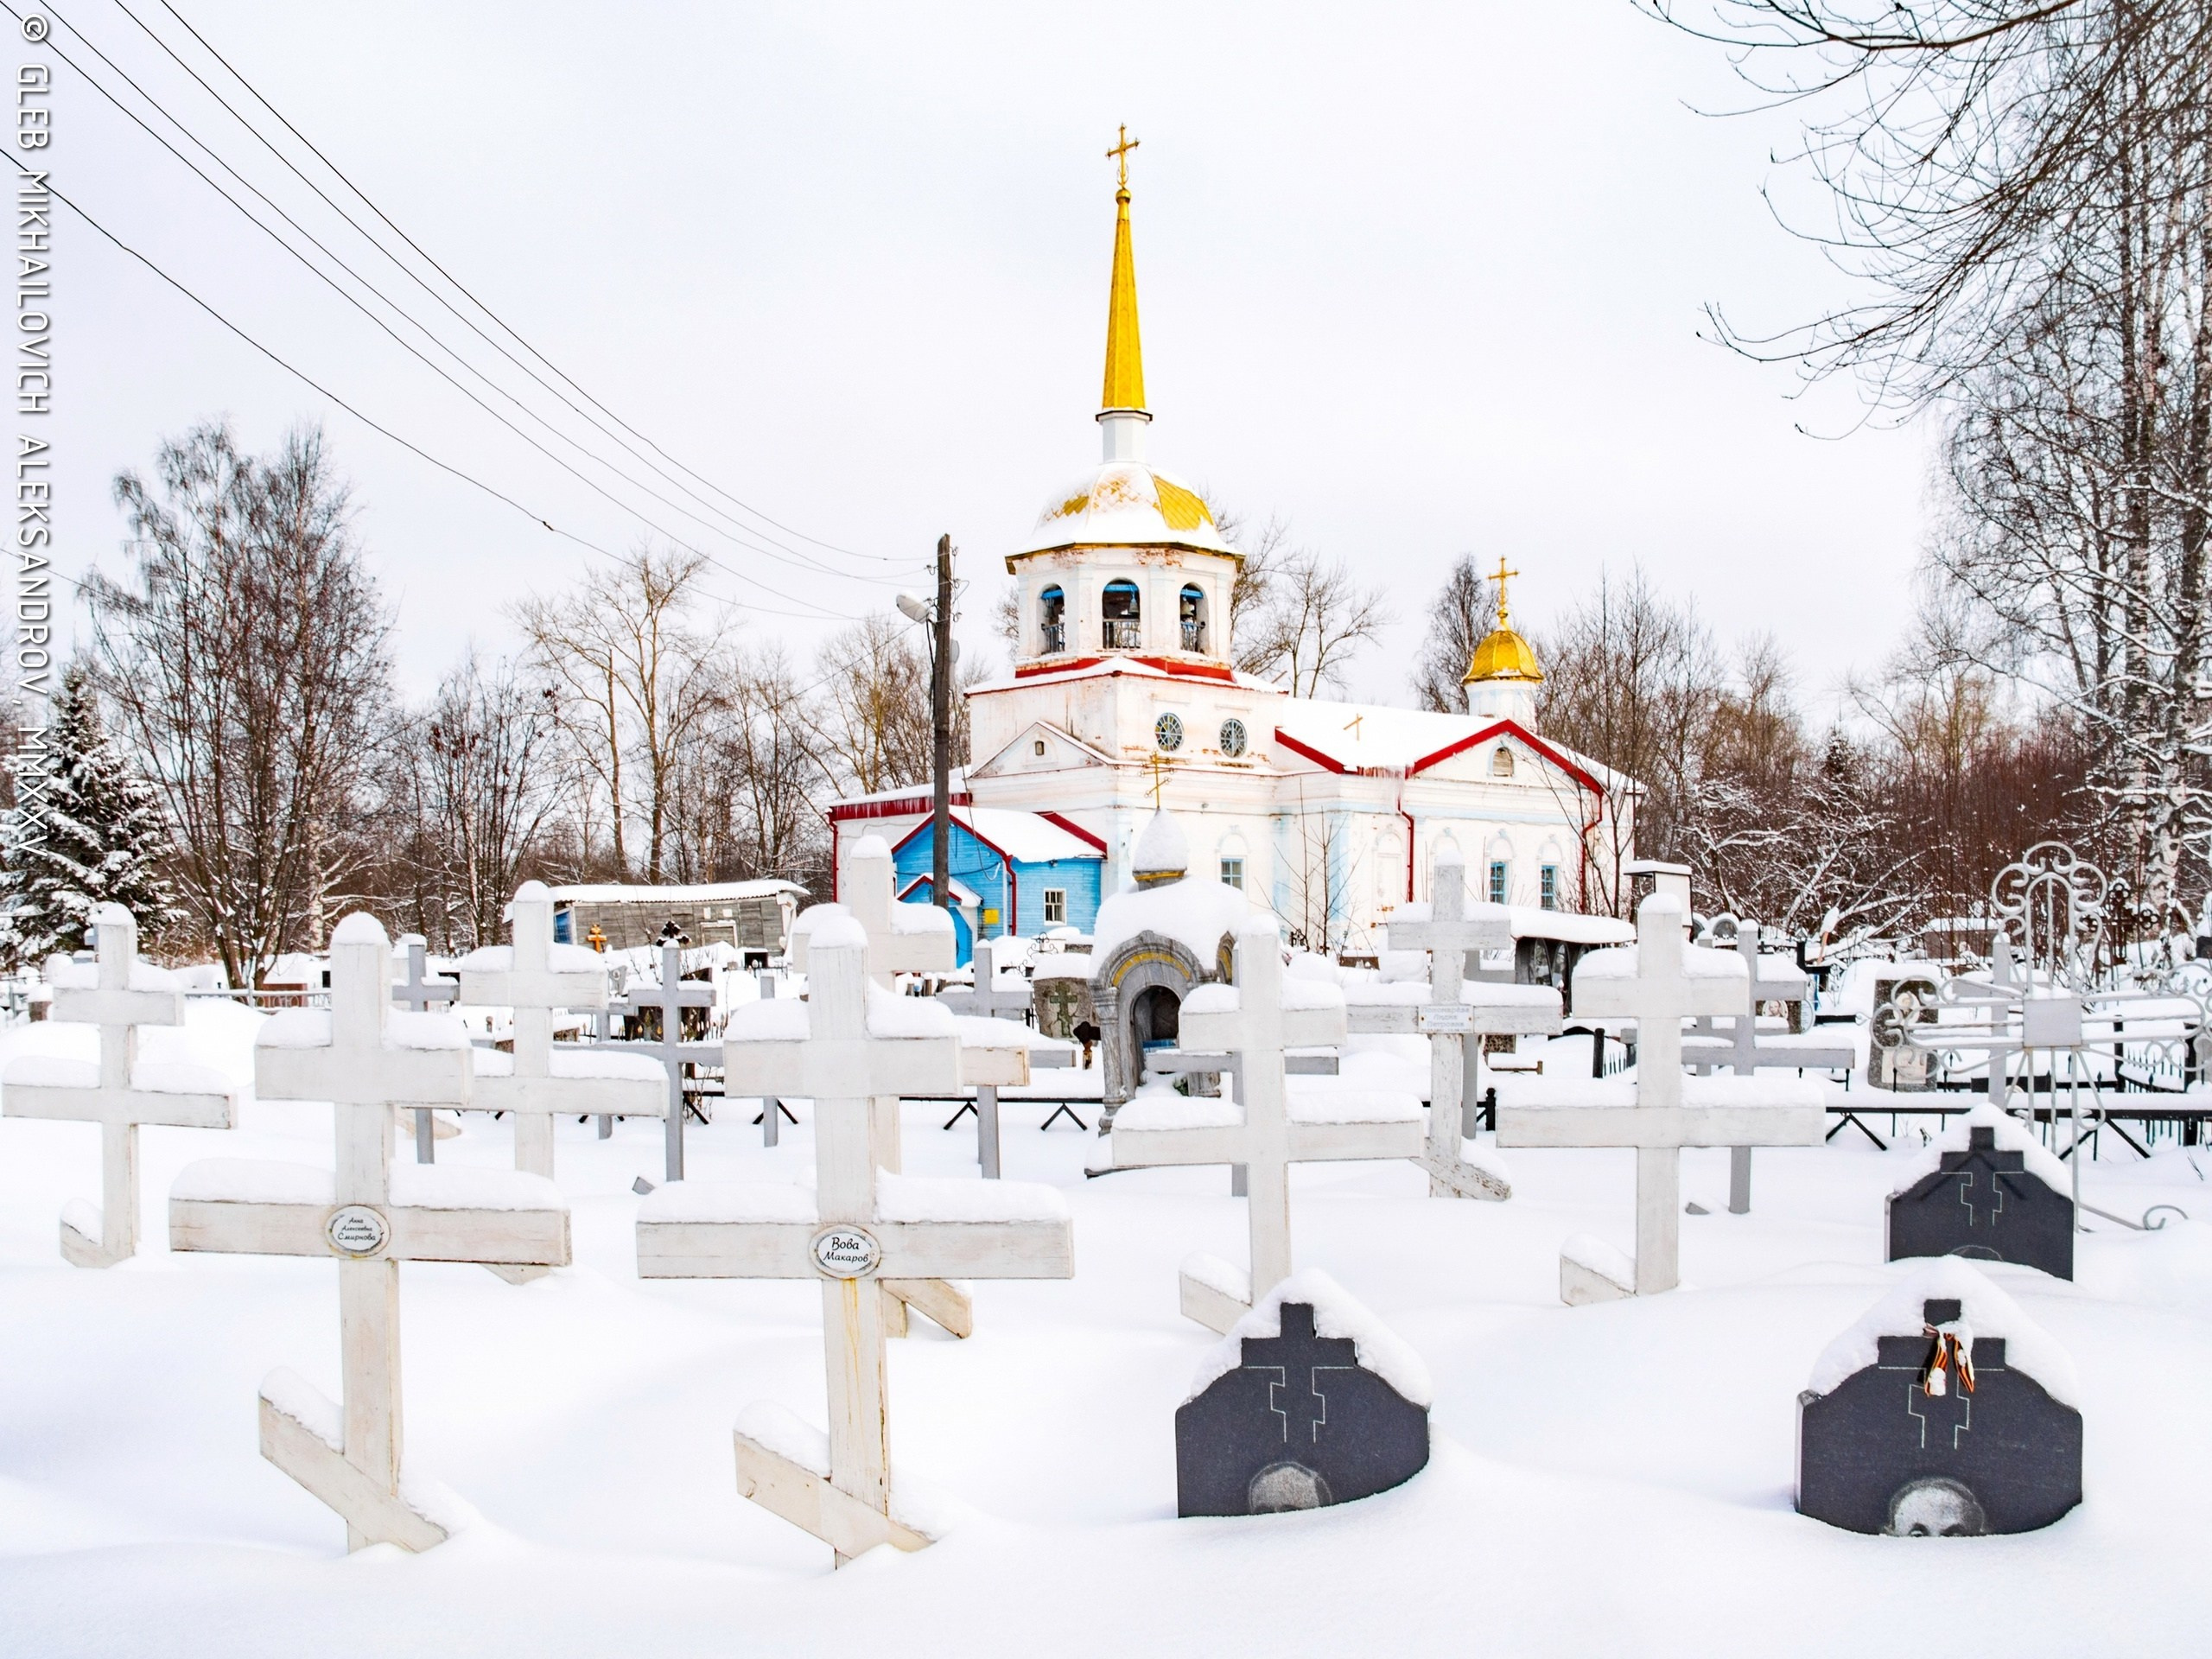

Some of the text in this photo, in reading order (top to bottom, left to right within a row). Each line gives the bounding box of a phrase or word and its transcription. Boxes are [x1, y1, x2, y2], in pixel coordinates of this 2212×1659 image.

[338, 1233, 376, 1242] Смирнова
[831, 1236, 860, 1250] Вова
[823, 1251, 869, 1263] Макаров
